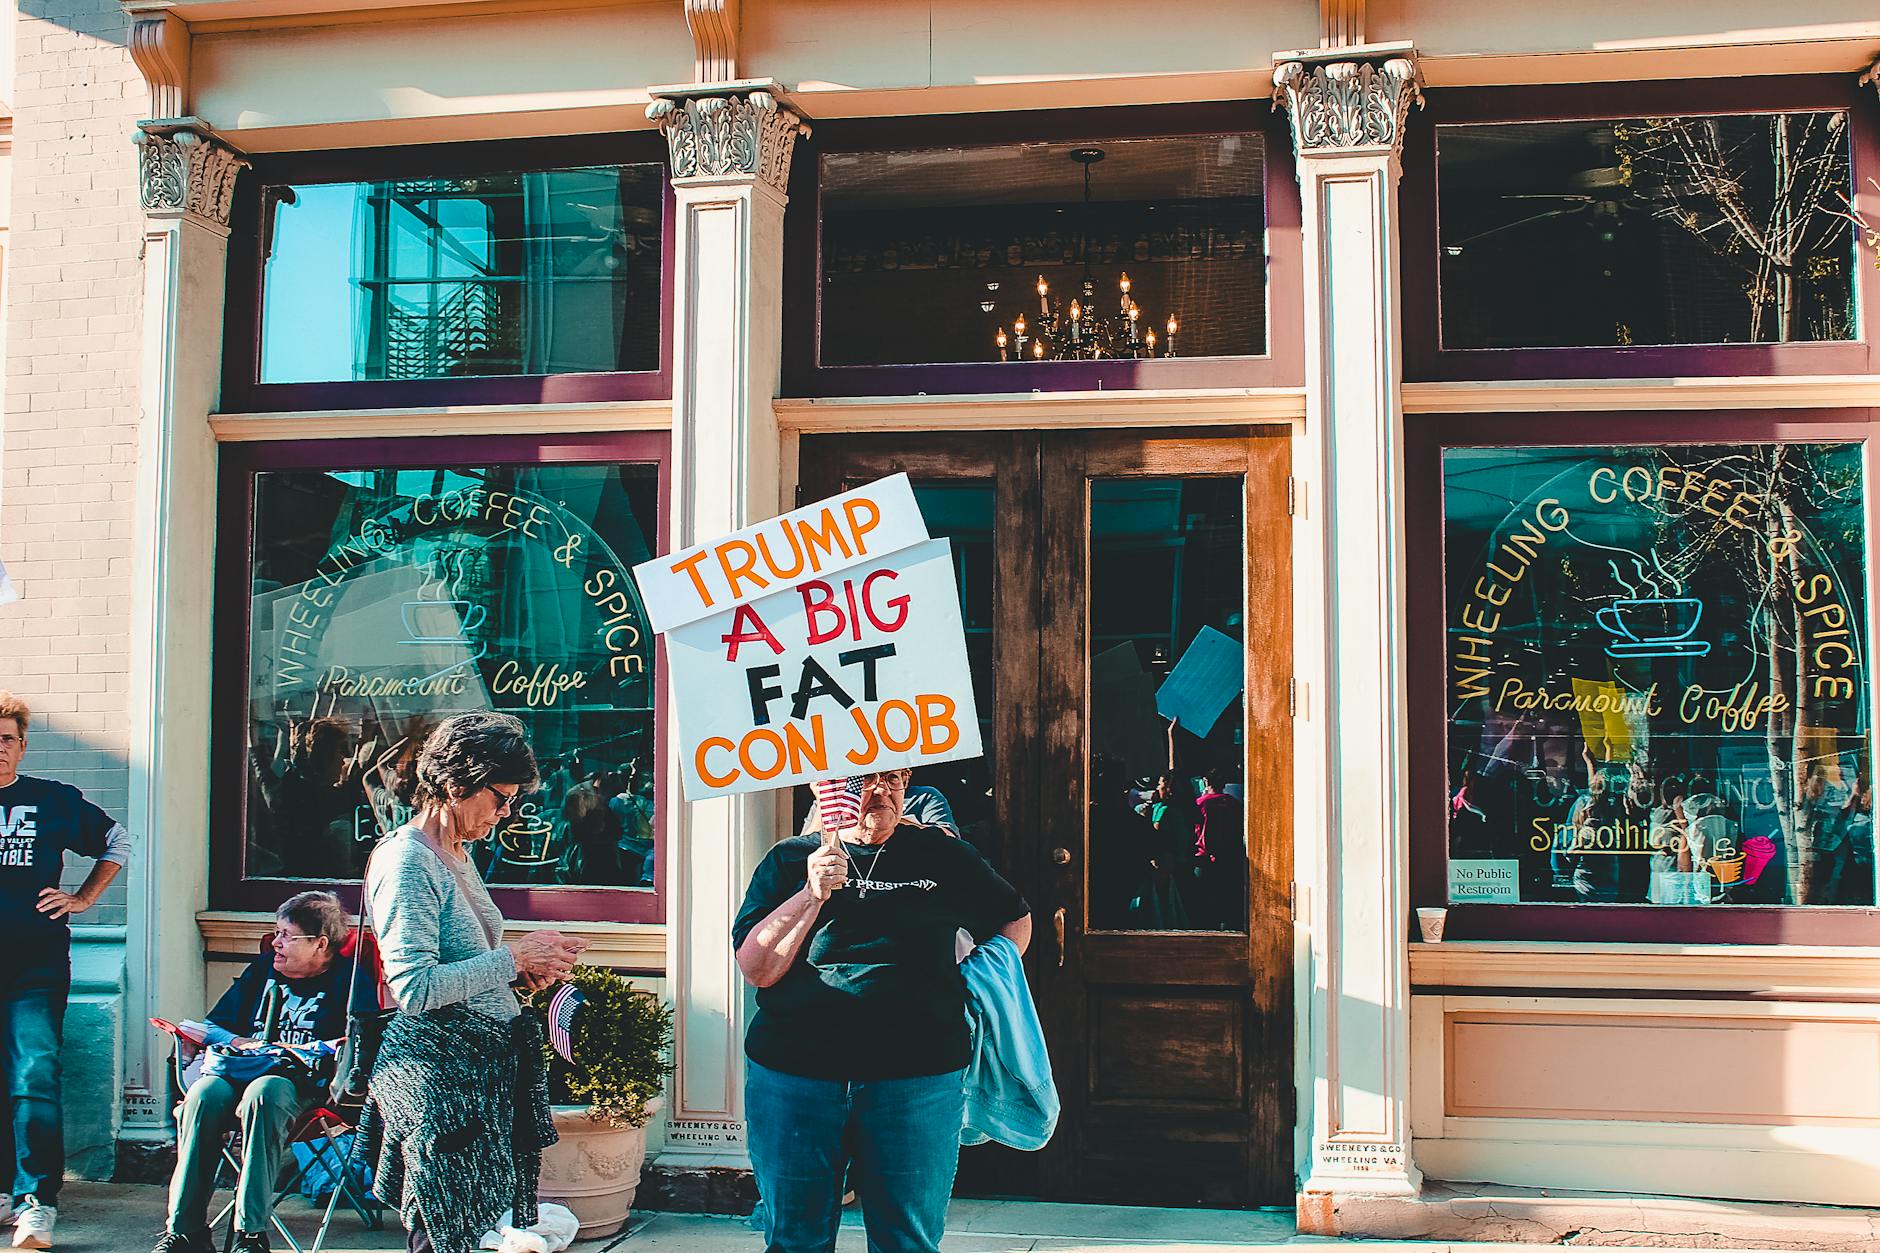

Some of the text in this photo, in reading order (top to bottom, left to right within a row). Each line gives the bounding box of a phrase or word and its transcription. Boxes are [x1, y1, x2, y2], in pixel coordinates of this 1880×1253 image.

[670, 498, 881, 608] TRUMP
[276, 489, 643, 687] WHEELING COFFEE & SPICE
[1454, 466, 1854, 699] WHEELING COFFEE & SPICE
[721, 569, 911, 662] A BIG
[323, 655, 587, 706] Paramount Coffee
[746, 643, 897, 725] FAT
[1495, 677, 1791, 733] Paramount Coffee
[695, 694, 960, 788] CON JOB
[1529, 817, 1690, 853] Smoothies
[1456, 868, 1512, 879] No Public
[1458, 884, 1511, 895] Restroom
[667, 1121, 719, 1130] SWEENEYS
[670, 1133, 720, 1141] WHEELING
[1319, 1143, 1377, 1152] SWEENEYS
[1322, 1156, 1378, 1164] WHEELING
